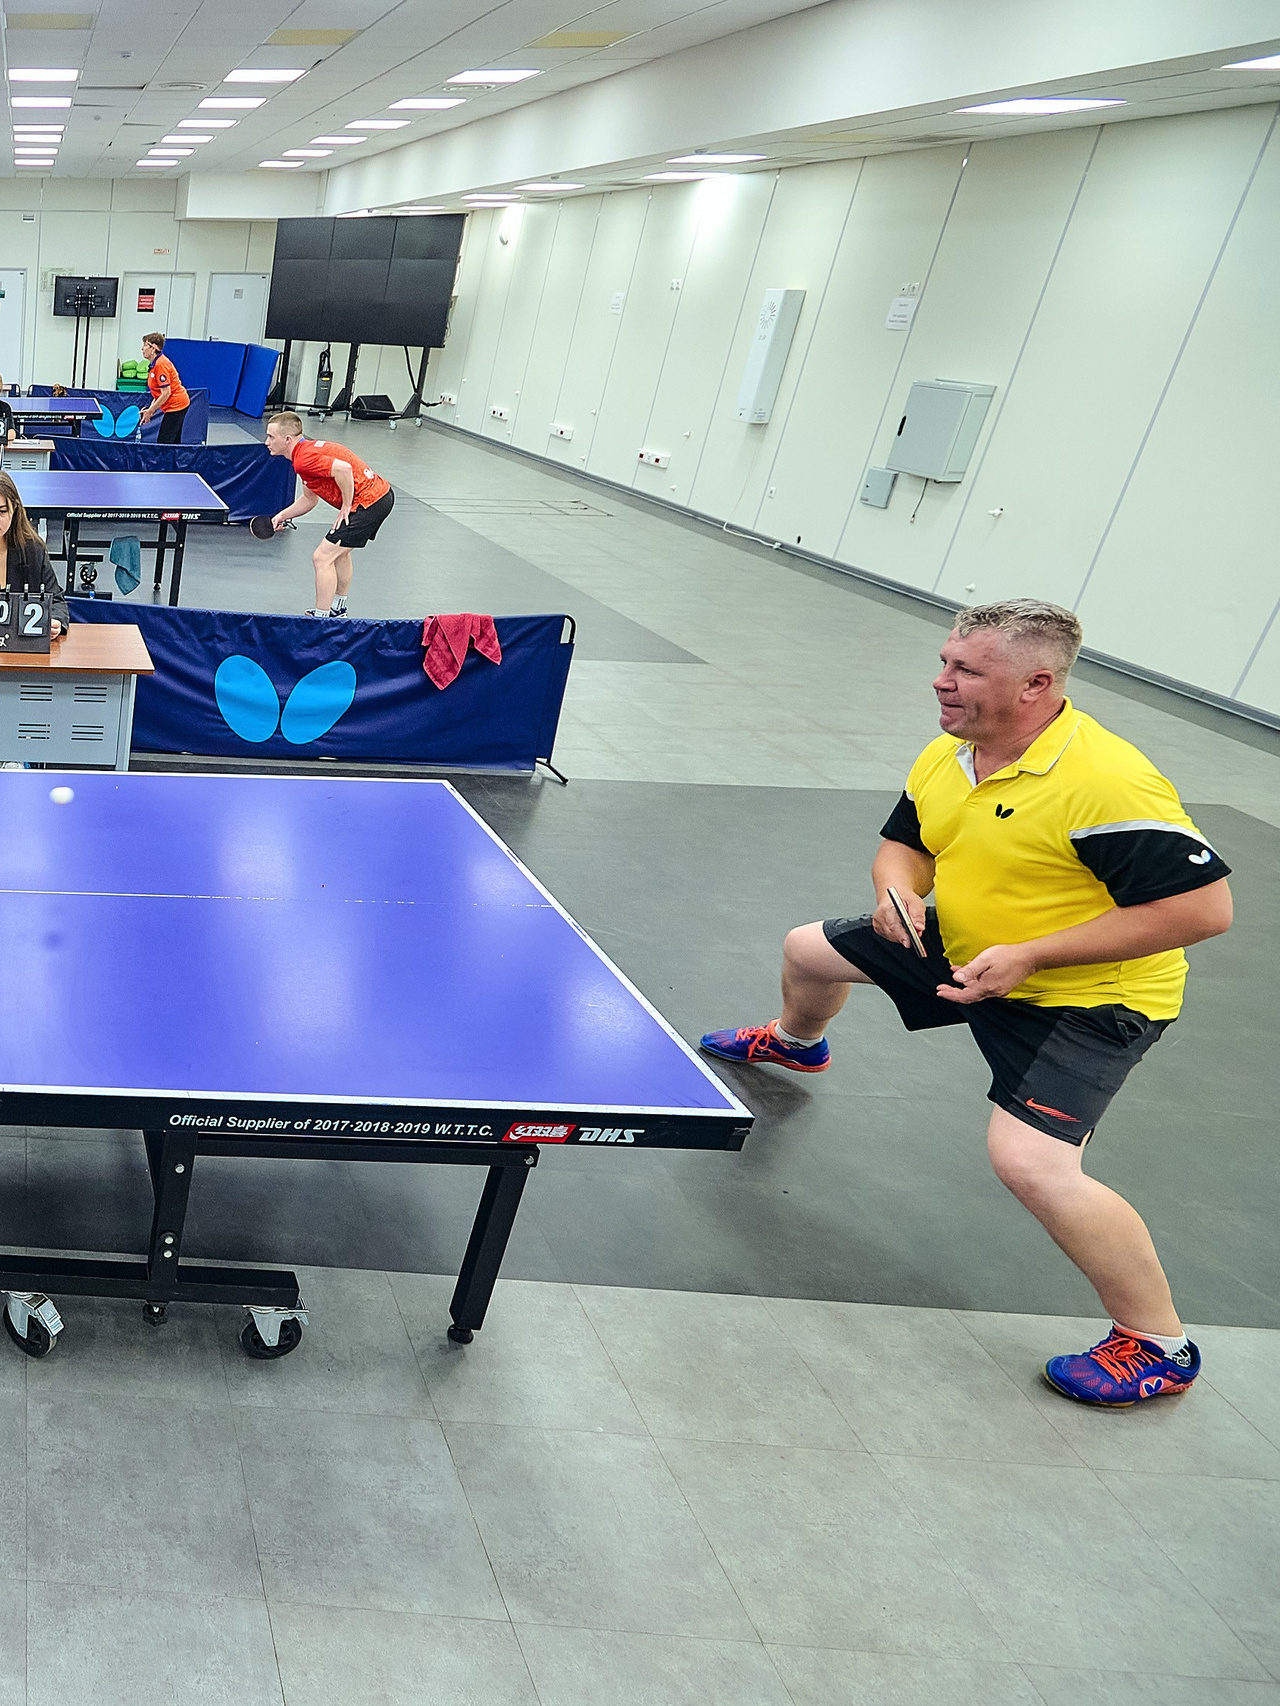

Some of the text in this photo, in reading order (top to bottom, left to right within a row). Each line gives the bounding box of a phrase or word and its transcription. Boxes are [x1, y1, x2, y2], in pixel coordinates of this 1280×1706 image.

[23, 603, 43, 634] 2
[169, 1114, 223, 1127] Official
[226, 1116, 292, 1131] Supplier
[293, 1118, 310, 1130] of
[434, 1123, 494, 1137] W.T.T.C.
[578, 1127, 645, 1143] DHS
